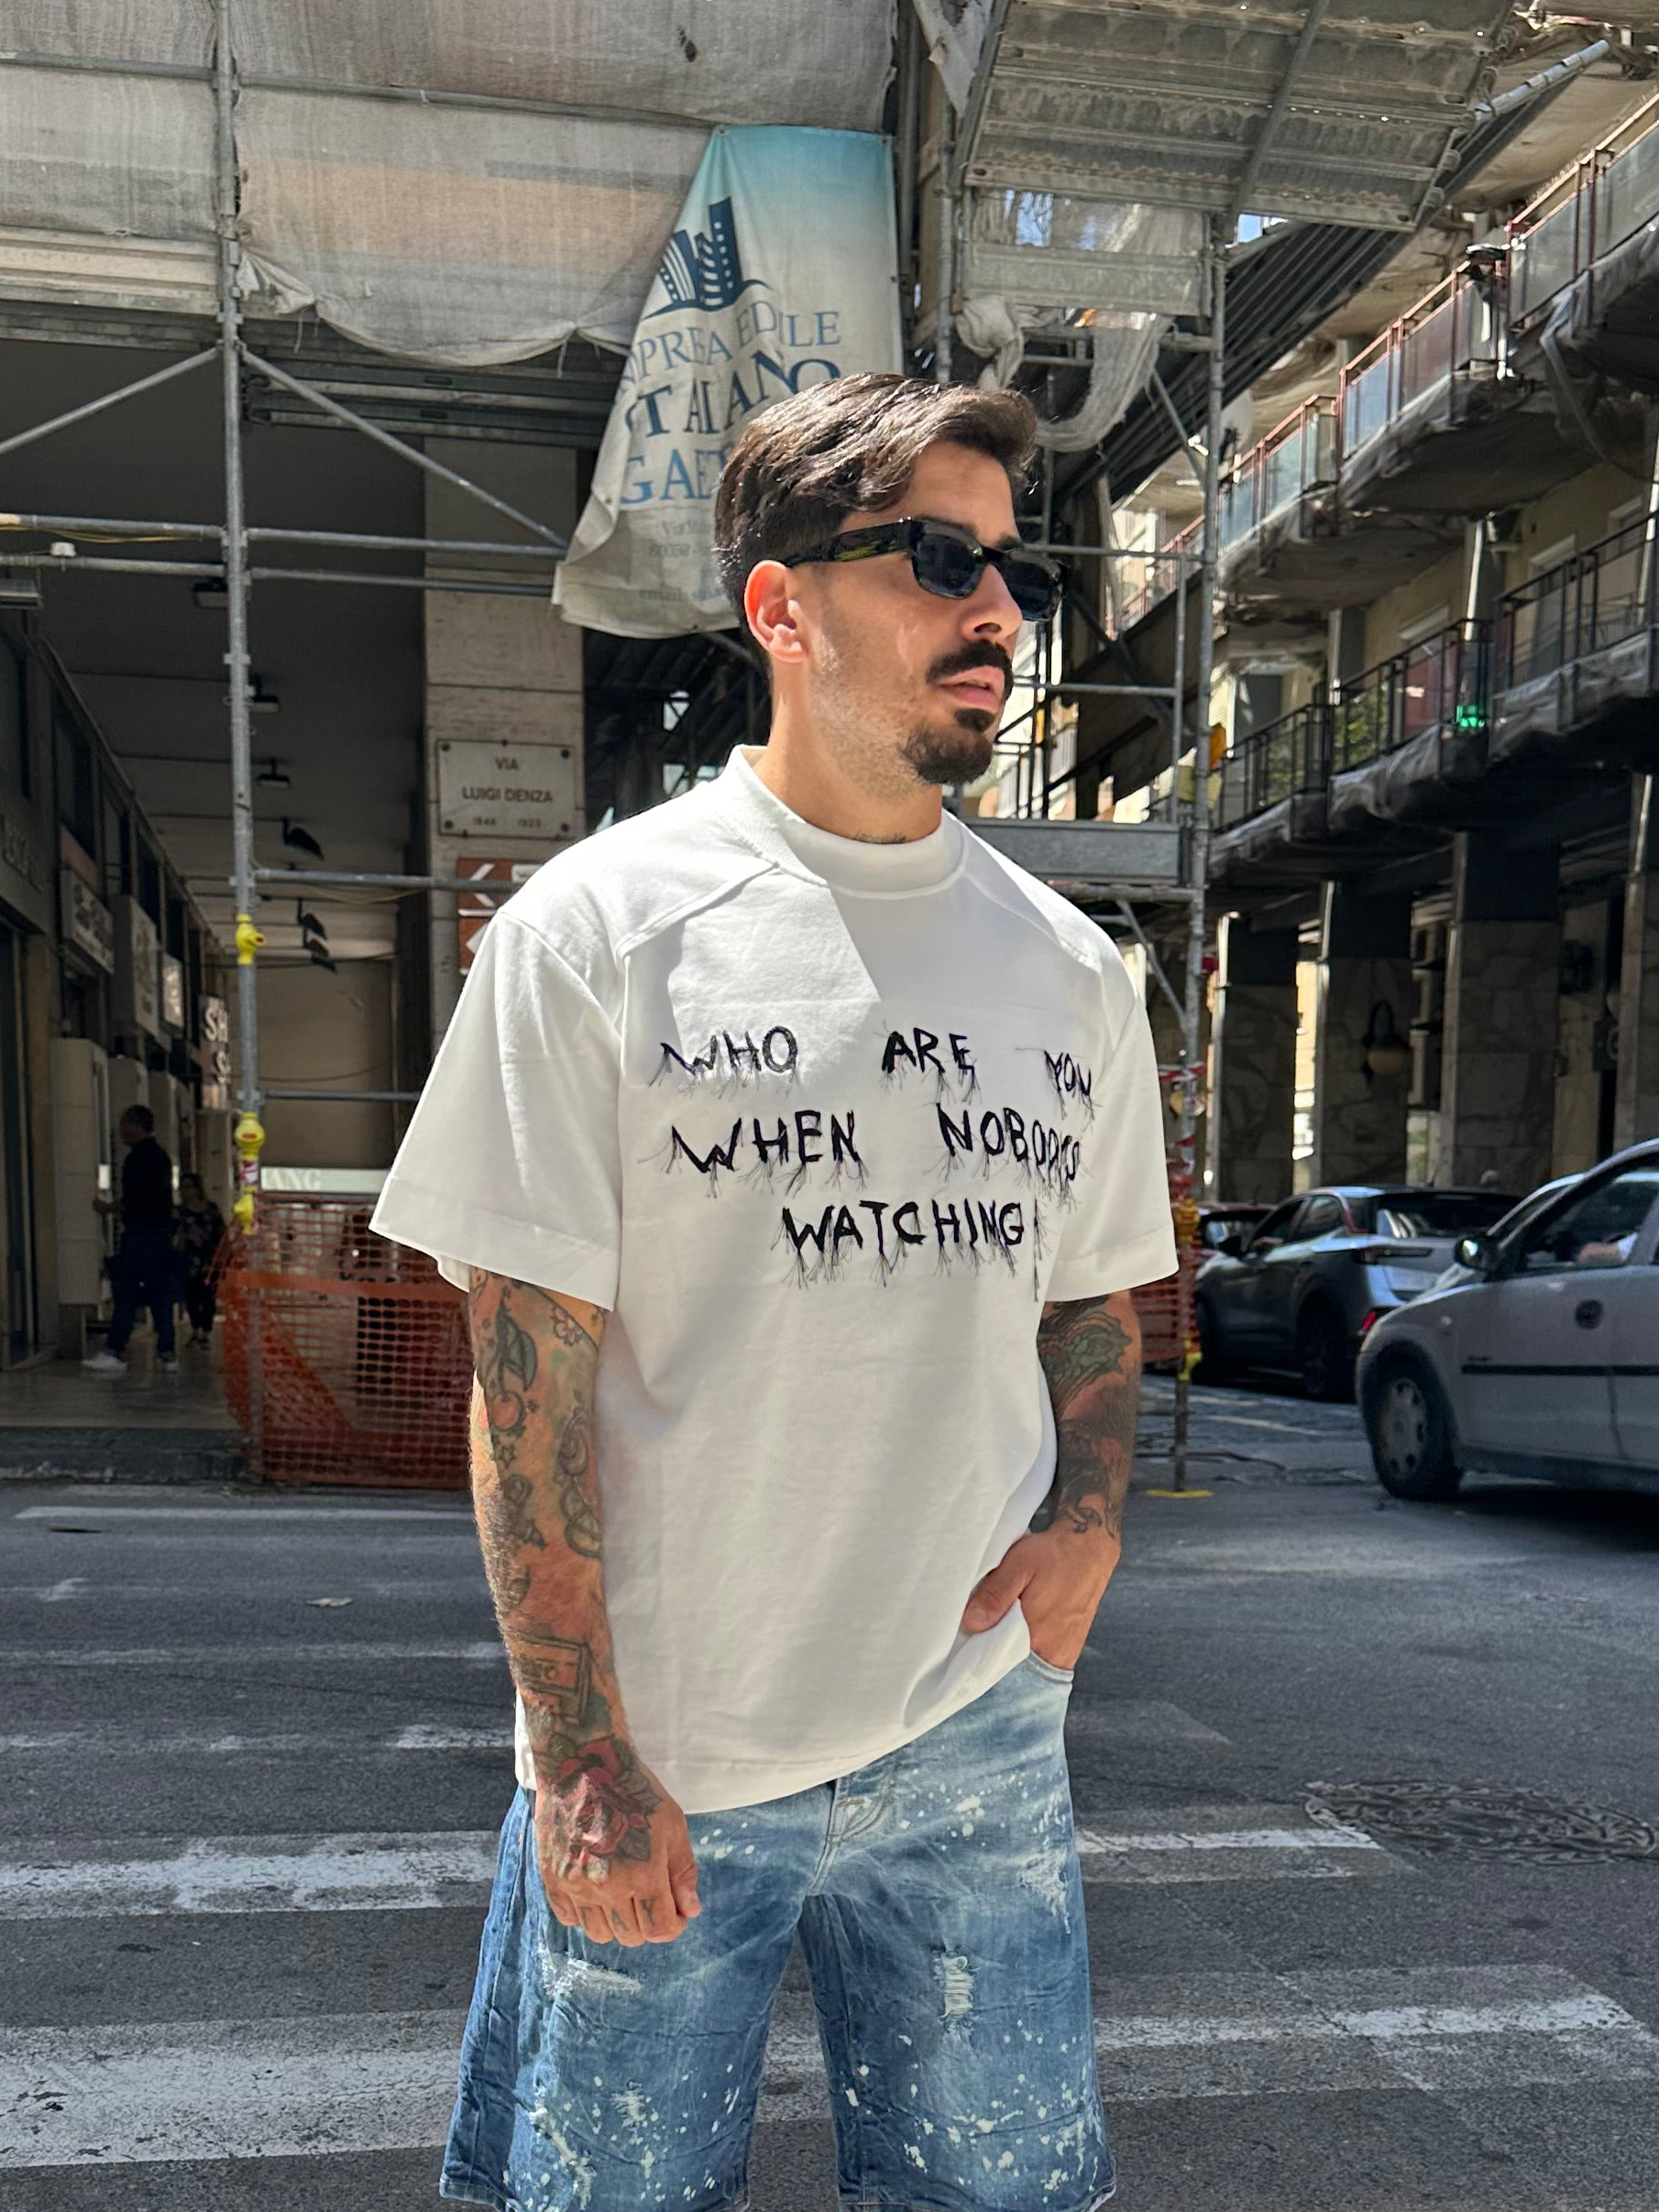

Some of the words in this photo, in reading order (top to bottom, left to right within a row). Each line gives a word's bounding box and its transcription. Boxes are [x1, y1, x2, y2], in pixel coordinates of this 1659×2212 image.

[495, 758, 520, 771] VIA
[462, 787, 501, 801] LUIGI
[504, 789, 554, 804] DENZA
[658, 1024, 799, 1083] WHO
[880, 1026, 978, 1083] ARE
[1043, 1048, 1093, 1104] YOU
[670, 1109, 862, 1180] WHEN
